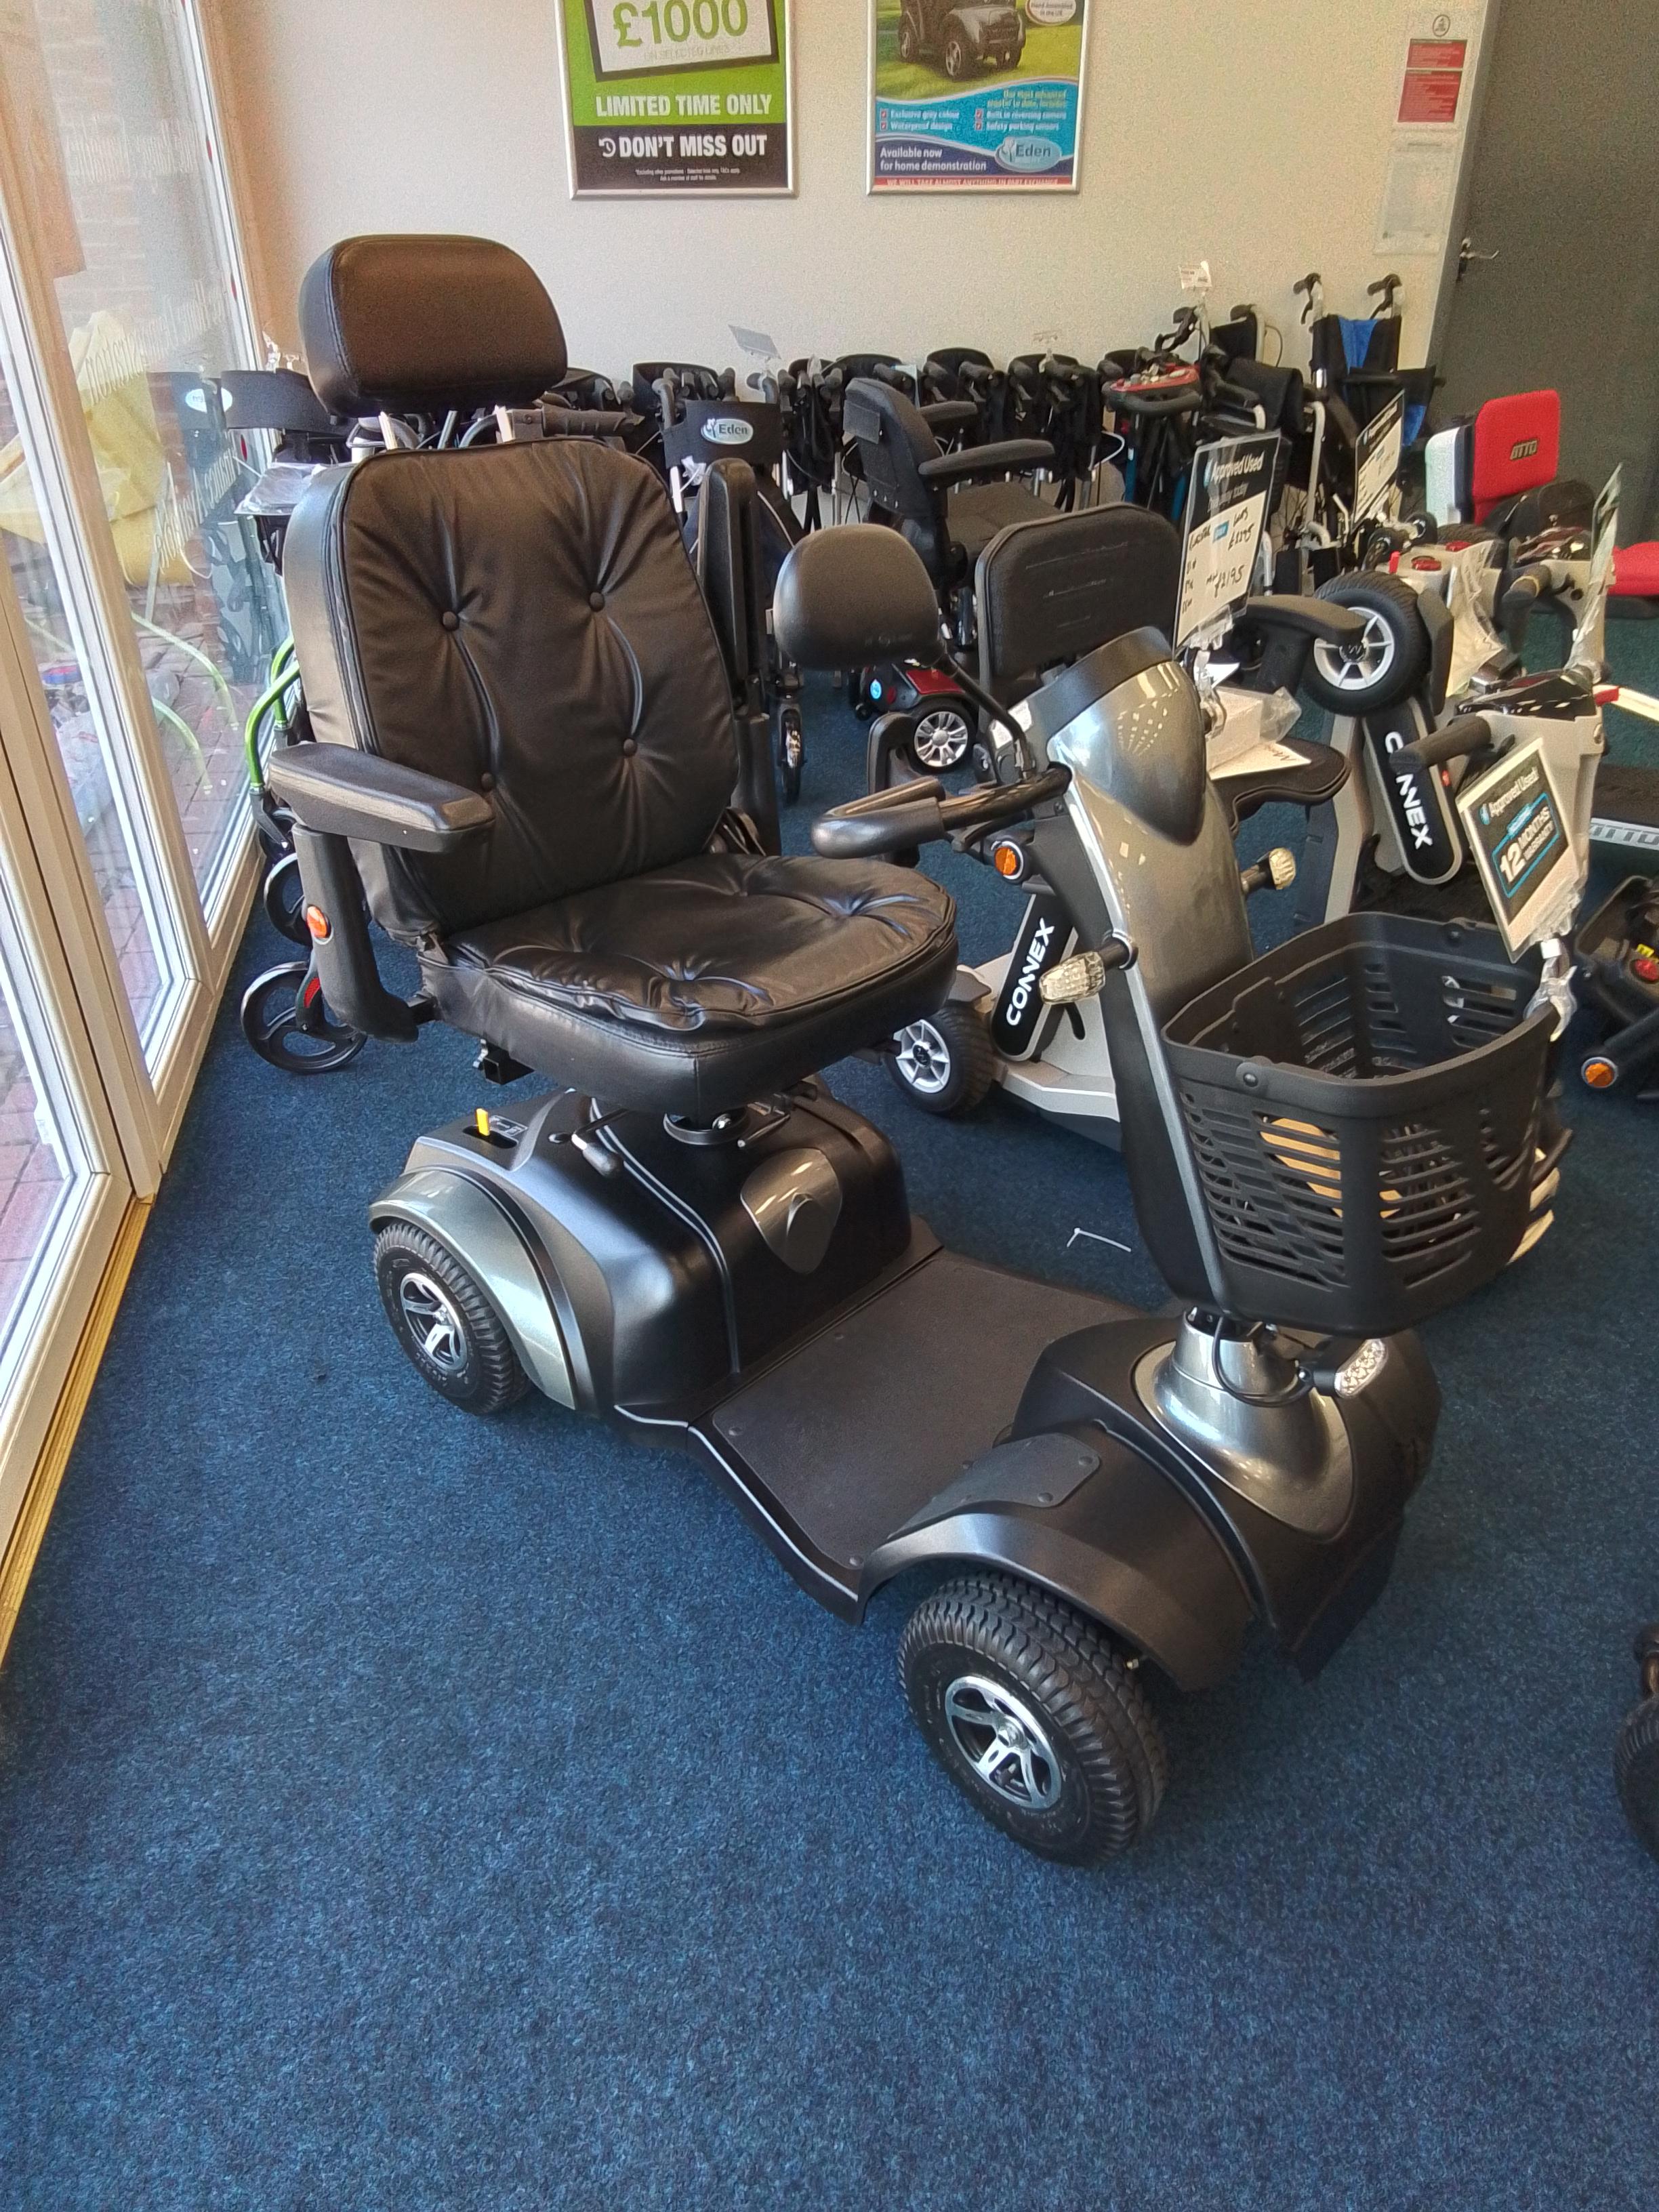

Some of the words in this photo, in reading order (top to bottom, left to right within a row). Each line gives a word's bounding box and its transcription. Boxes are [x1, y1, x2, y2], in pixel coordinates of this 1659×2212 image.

[613, 0, 748, 47] £1000
[596, 96, 671, 117] LIMITED
[675, 95, 720, 116] TIME
[726, 94, 773, 115] ONLY
[619, 136, 674, 158] DON'T
[680, 135, 726, 157] MISS
[732, 134, 767, 156] OUT
[880, 147, 922, 158] Available
[923, 148, 943, 158] now
[1016, 144, 1051, 157] Eden
[880, 159, 893, 170] for
[895, 160, 920, 170] home
[922, 159, 987, 170] demonstration
[718, 424, 748, 435] Eden
[1210, 455, 1246, 485] Approved
[1243, 450, 1265, 474] Used
[1488, 781, 1522, 817] Approved
[1517, 766, 1540, 792] Used
[1500, 842, 1526, 882] 12
[1517, 806, 1551, 849] MONTHS
